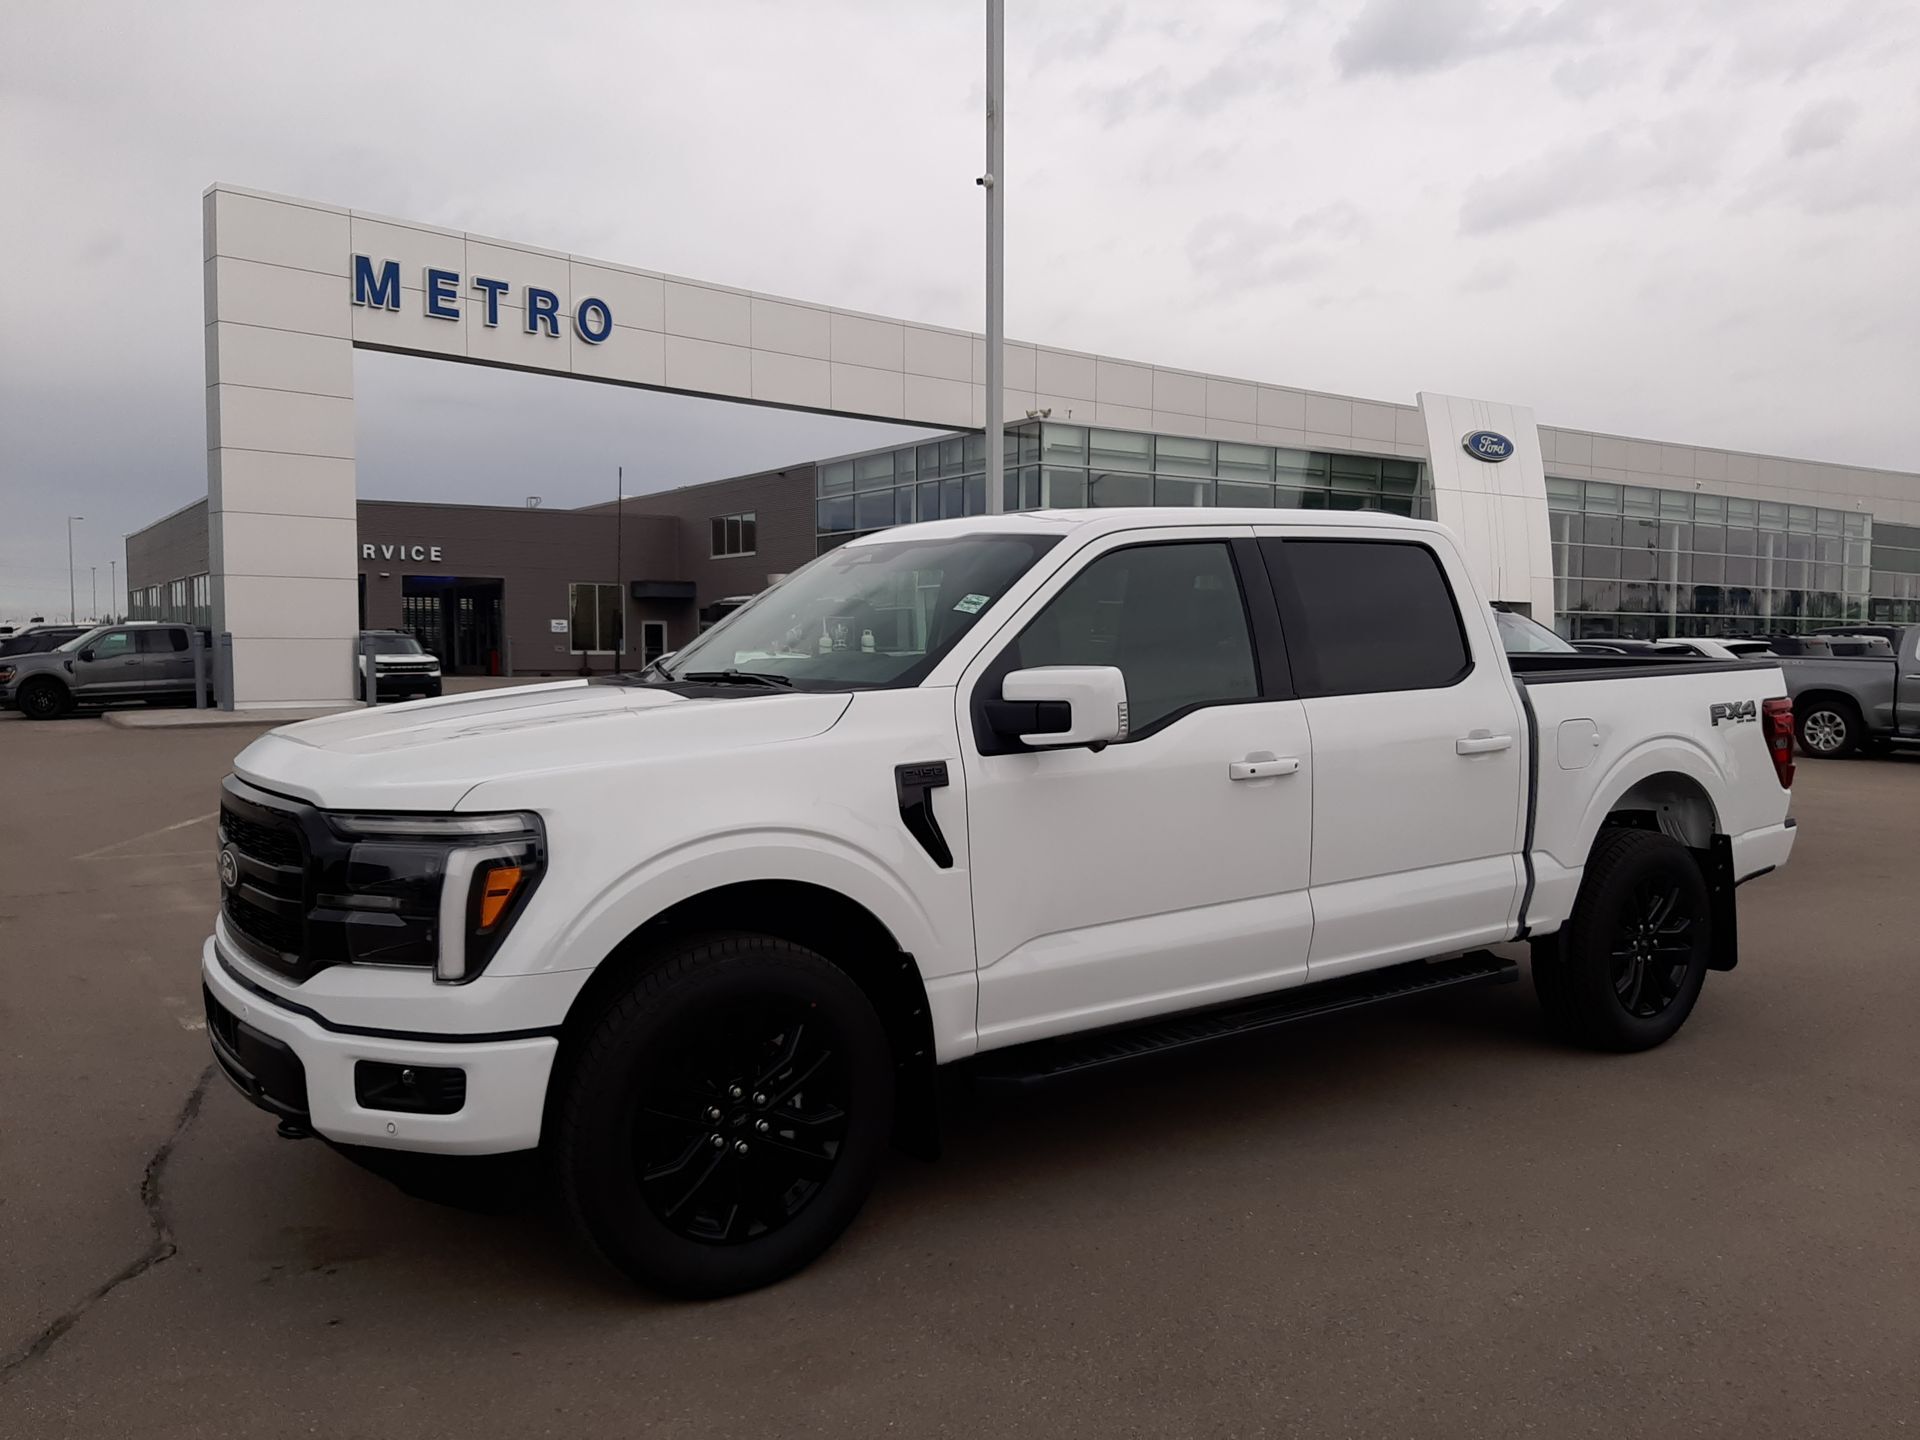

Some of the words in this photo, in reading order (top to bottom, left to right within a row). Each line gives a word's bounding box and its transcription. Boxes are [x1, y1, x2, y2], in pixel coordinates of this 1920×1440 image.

[351, 254, 613, 344] METRO
[1479, 436, 1505, 454] Ford
[362, 544, 442, 561] RVICE
[1710, 700, 1756, 726] FX4
